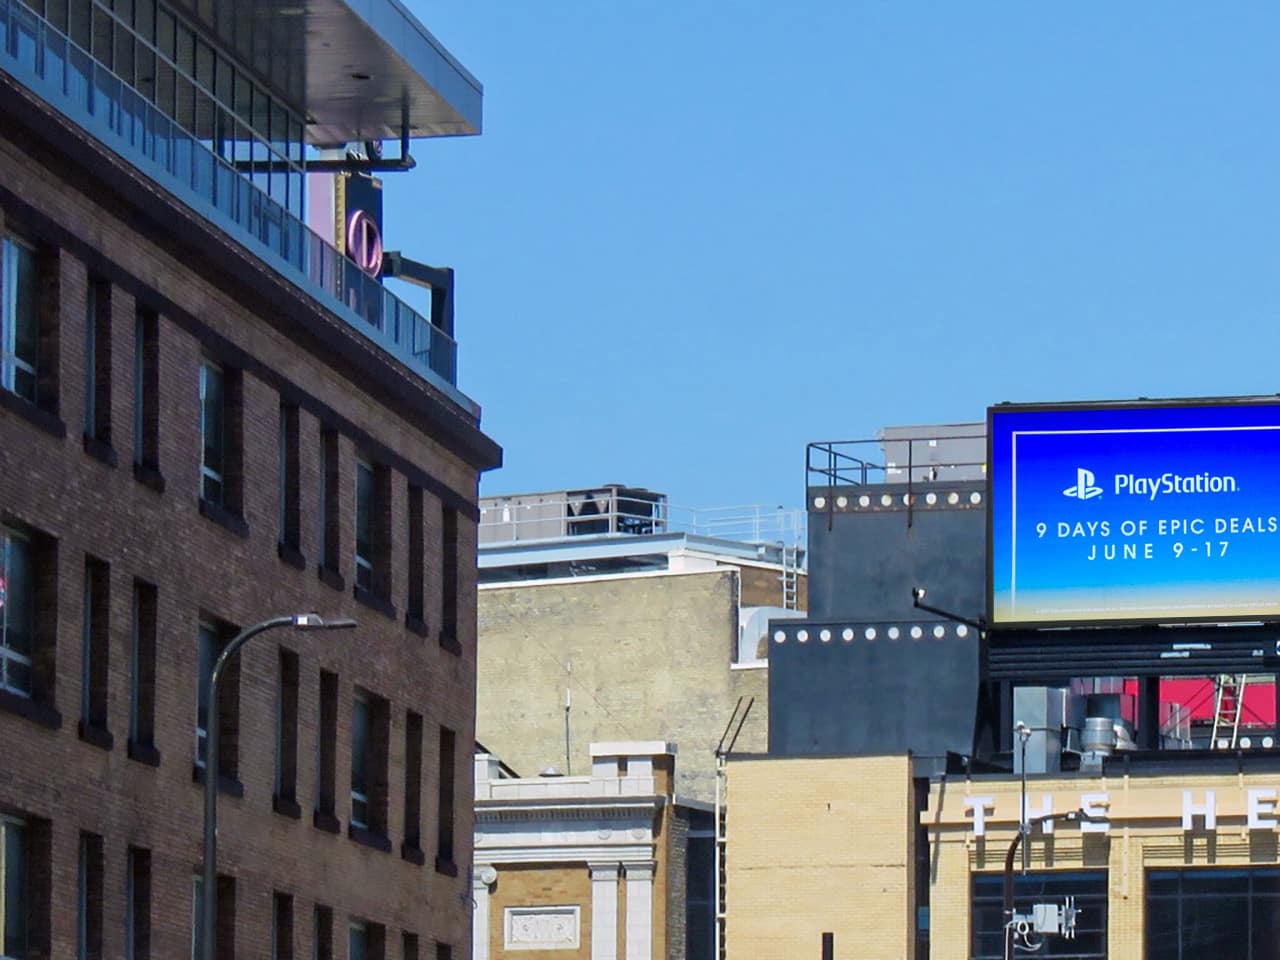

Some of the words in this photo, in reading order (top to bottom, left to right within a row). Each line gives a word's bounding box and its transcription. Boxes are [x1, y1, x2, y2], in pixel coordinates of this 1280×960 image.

[1114, 472, 1236, 501] PlayStation
[1036, 522, 1047, 538] 9
[1057, 521, 1111, 538] DAYS
[1120, 520, 1148, 536] OF
[1158, 519, 1205, 535] EPIC
[1214, 516, 1278, 534] DEALS
[1087, 543, 1154, 560] JUNE
[963, 792, 1110, 836] THE
